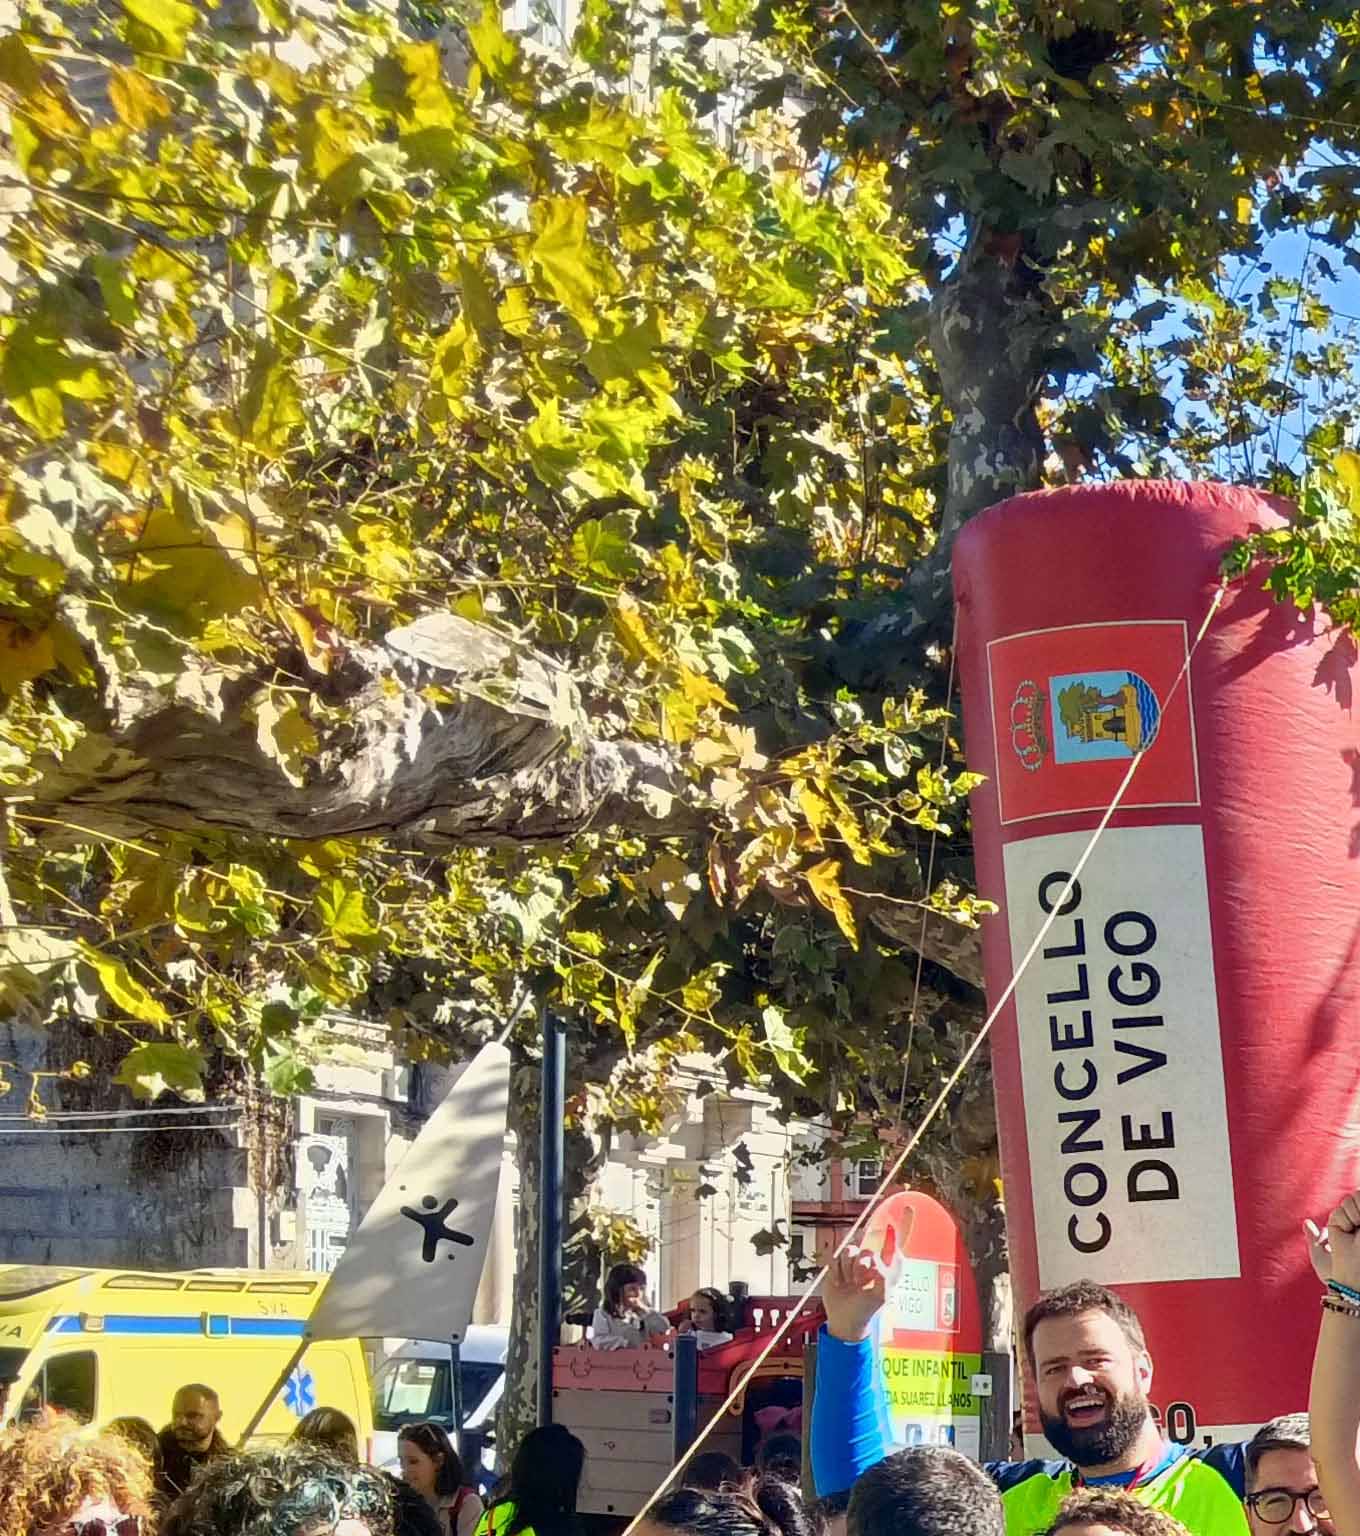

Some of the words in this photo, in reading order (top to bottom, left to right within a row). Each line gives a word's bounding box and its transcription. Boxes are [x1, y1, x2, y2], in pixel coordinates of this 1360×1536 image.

[1038, 871, 1112, 1253] CONCELLO
[1103, 910, 1167, 1085] VIGO
[1121, 1111, 1180, 1202] DE
[912, 1360, 968, 1380] INFANTIL
